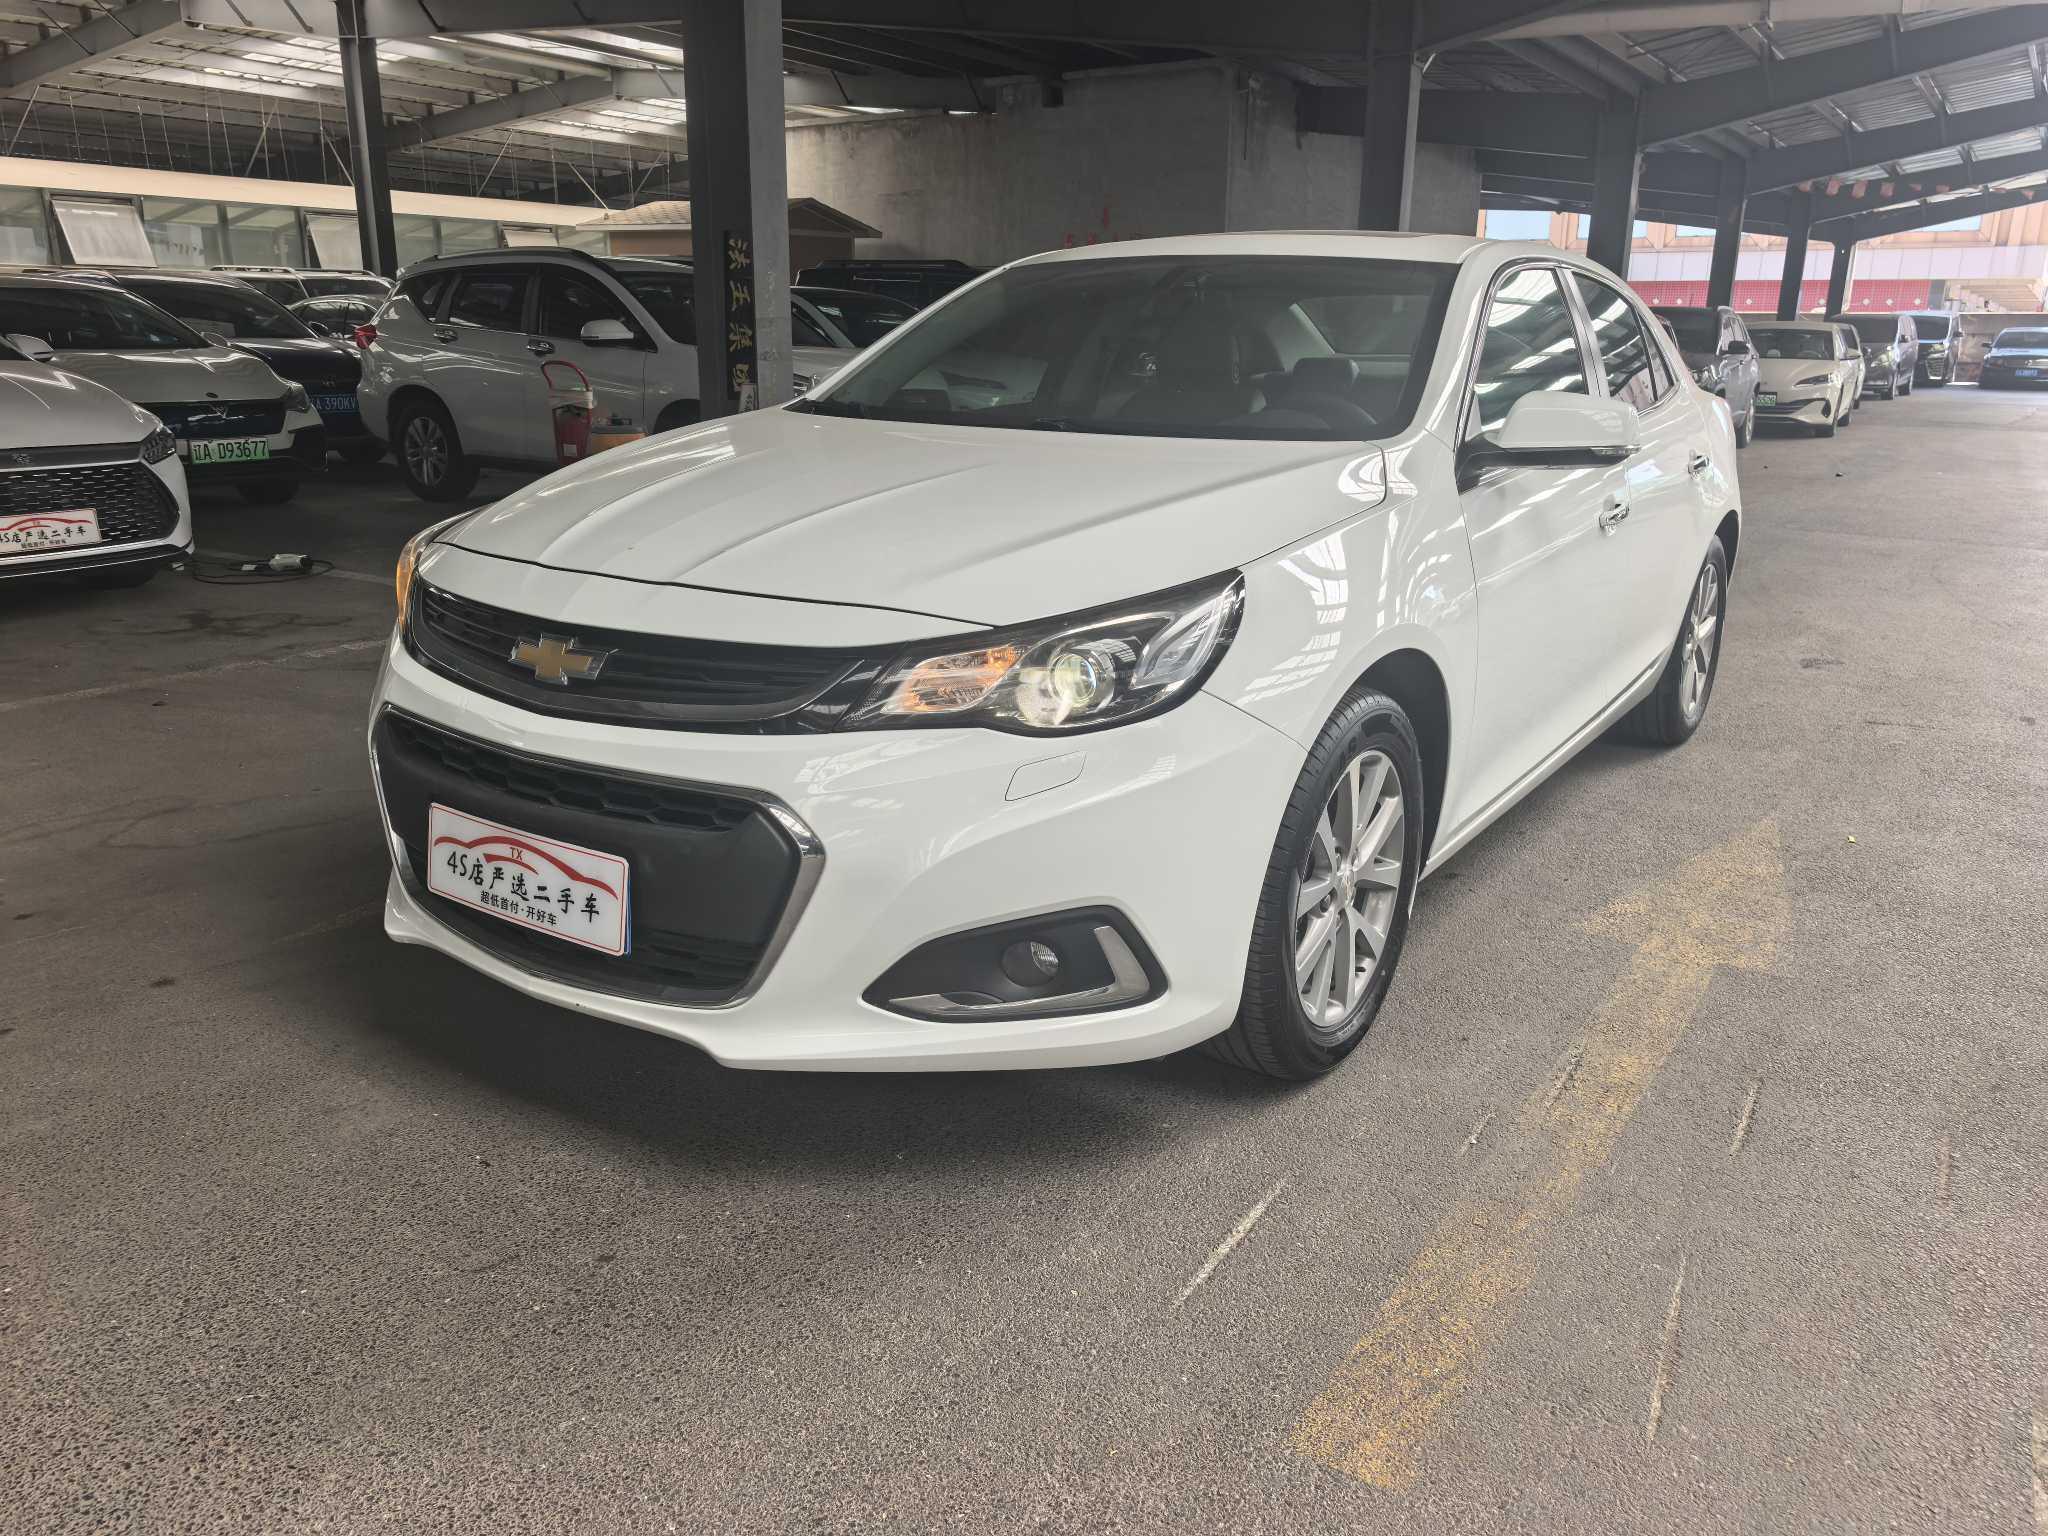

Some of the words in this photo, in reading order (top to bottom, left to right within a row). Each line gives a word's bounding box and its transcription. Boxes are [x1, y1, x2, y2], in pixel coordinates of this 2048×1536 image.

[446, 850, 601, 924] 4S店严选二手车
